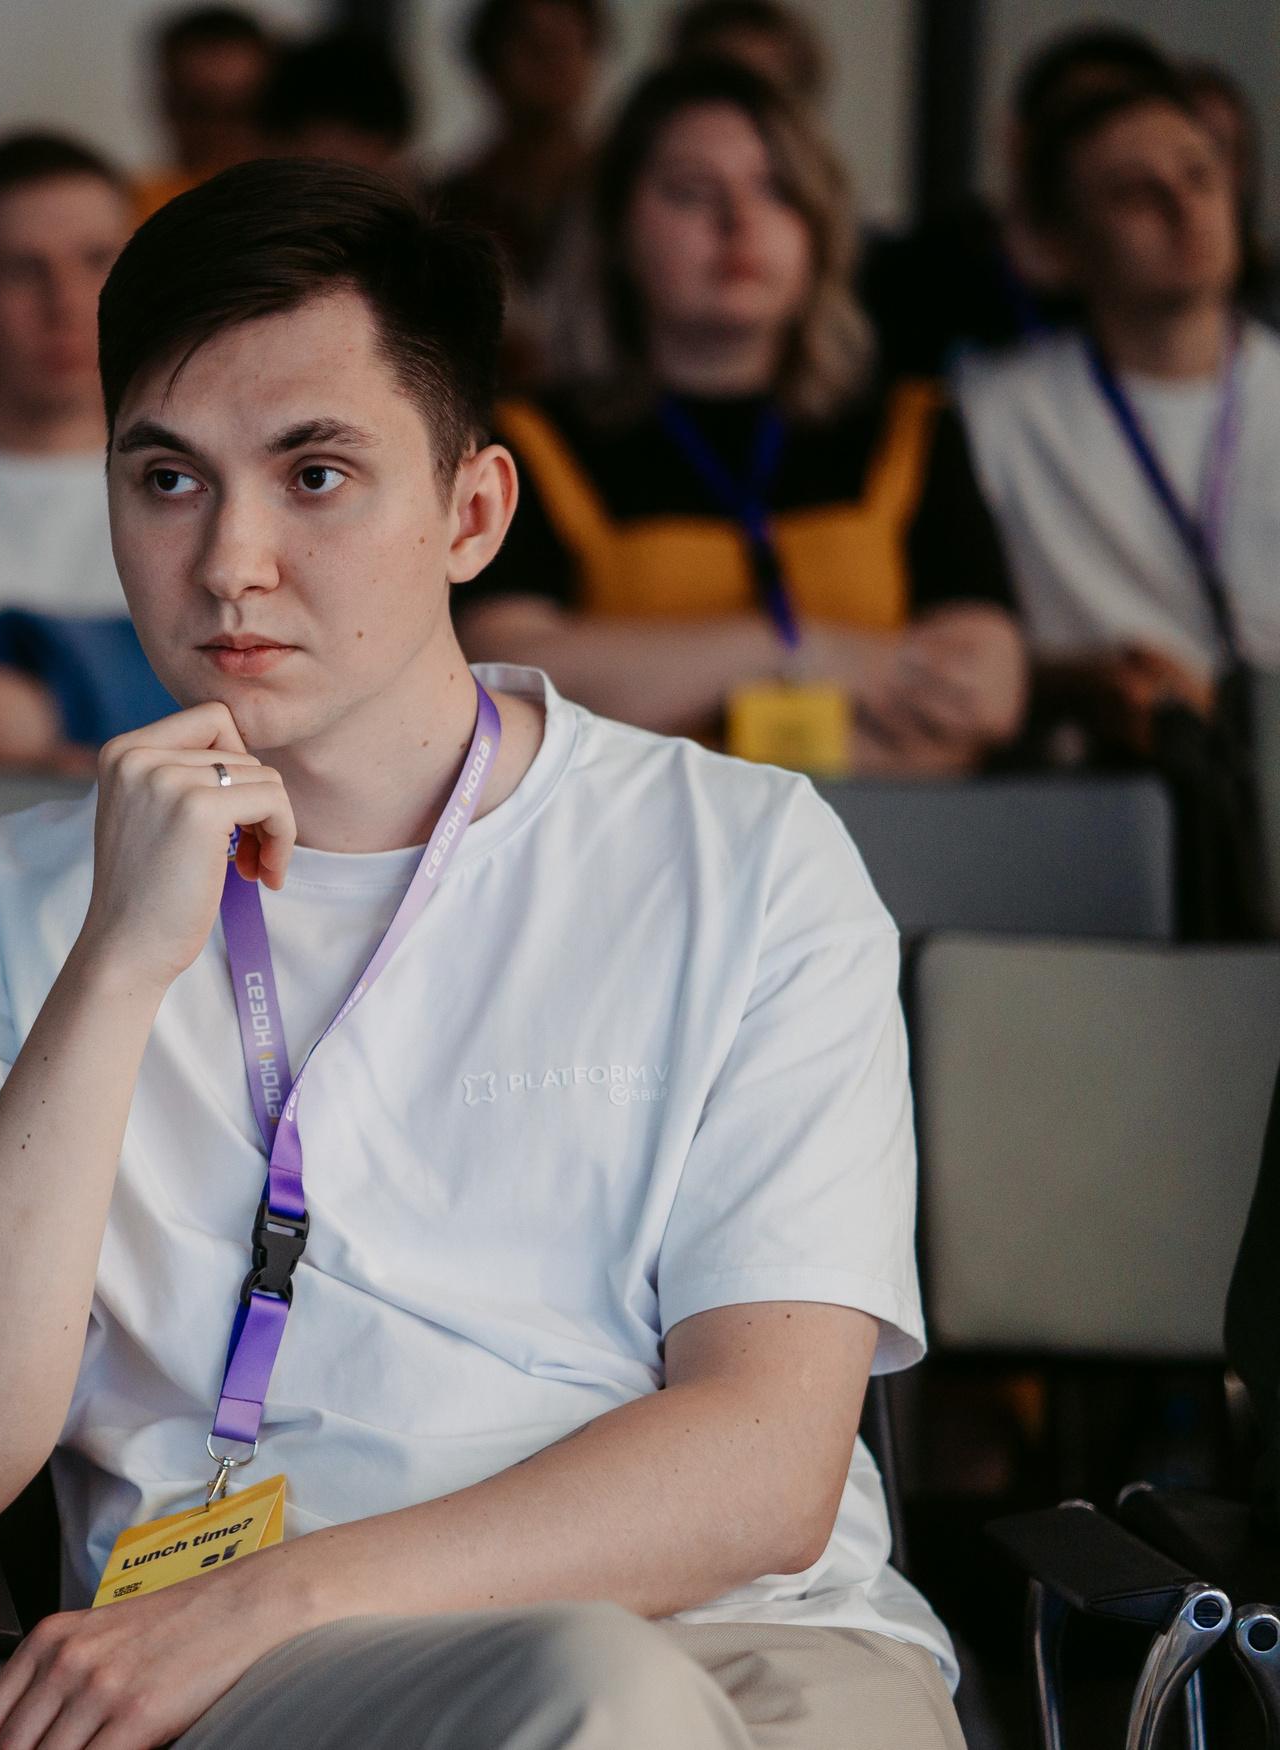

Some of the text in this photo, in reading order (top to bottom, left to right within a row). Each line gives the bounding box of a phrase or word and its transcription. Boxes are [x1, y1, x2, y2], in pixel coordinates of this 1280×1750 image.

[507, 1065, 646, 1093] PLATFORM
[121, 1517, 254, 1570] Lunch time?
